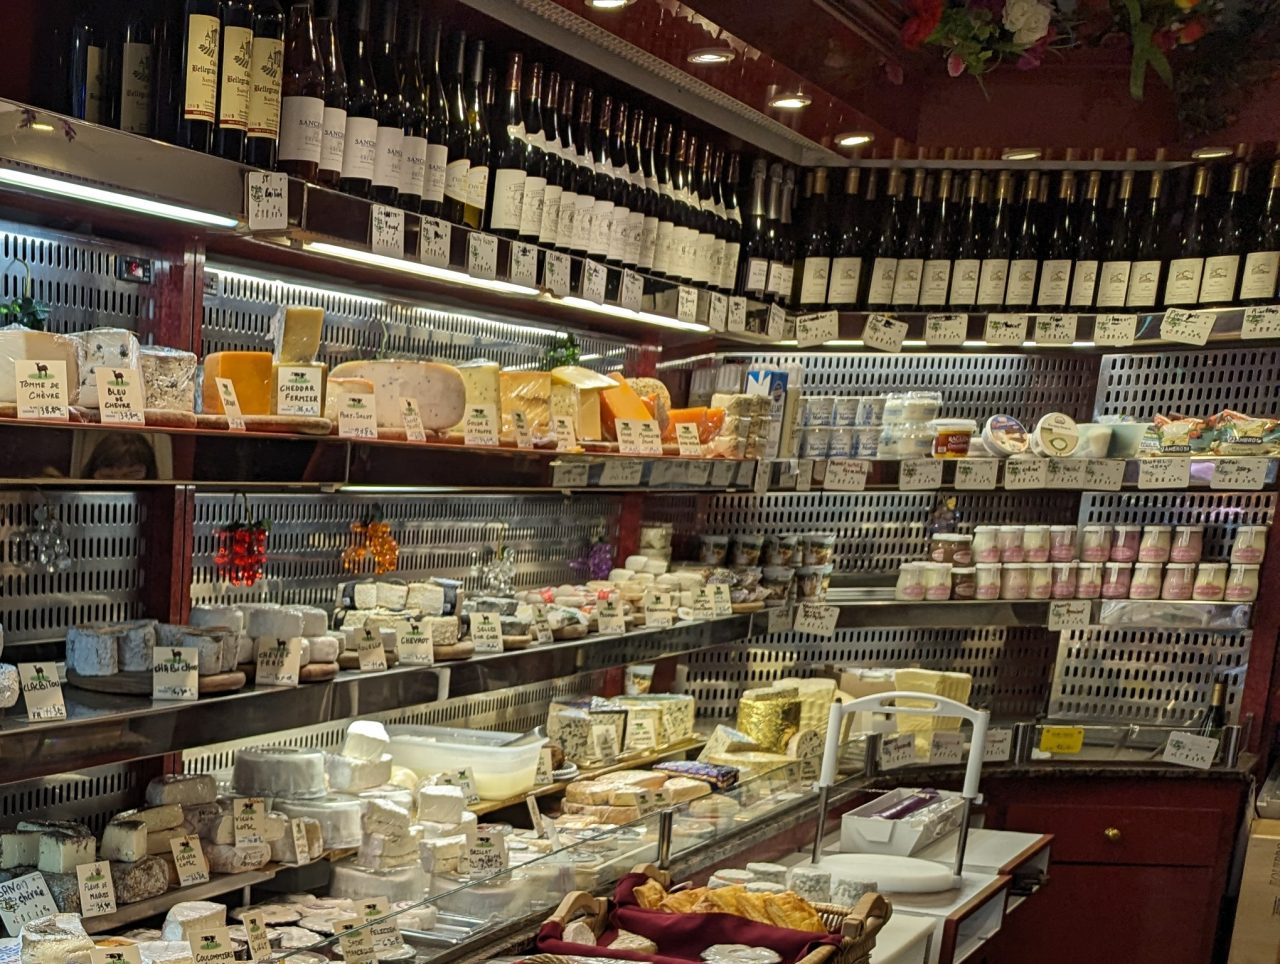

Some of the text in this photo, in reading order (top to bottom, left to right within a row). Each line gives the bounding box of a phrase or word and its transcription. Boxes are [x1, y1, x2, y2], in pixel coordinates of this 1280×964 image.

[19, 380, 46, 389] TOMME
[279, 384, 315, 393] CHEDDAR
[107, 387, 127, 396] BLEU
[284, 394, 319, 404] FERMIER
